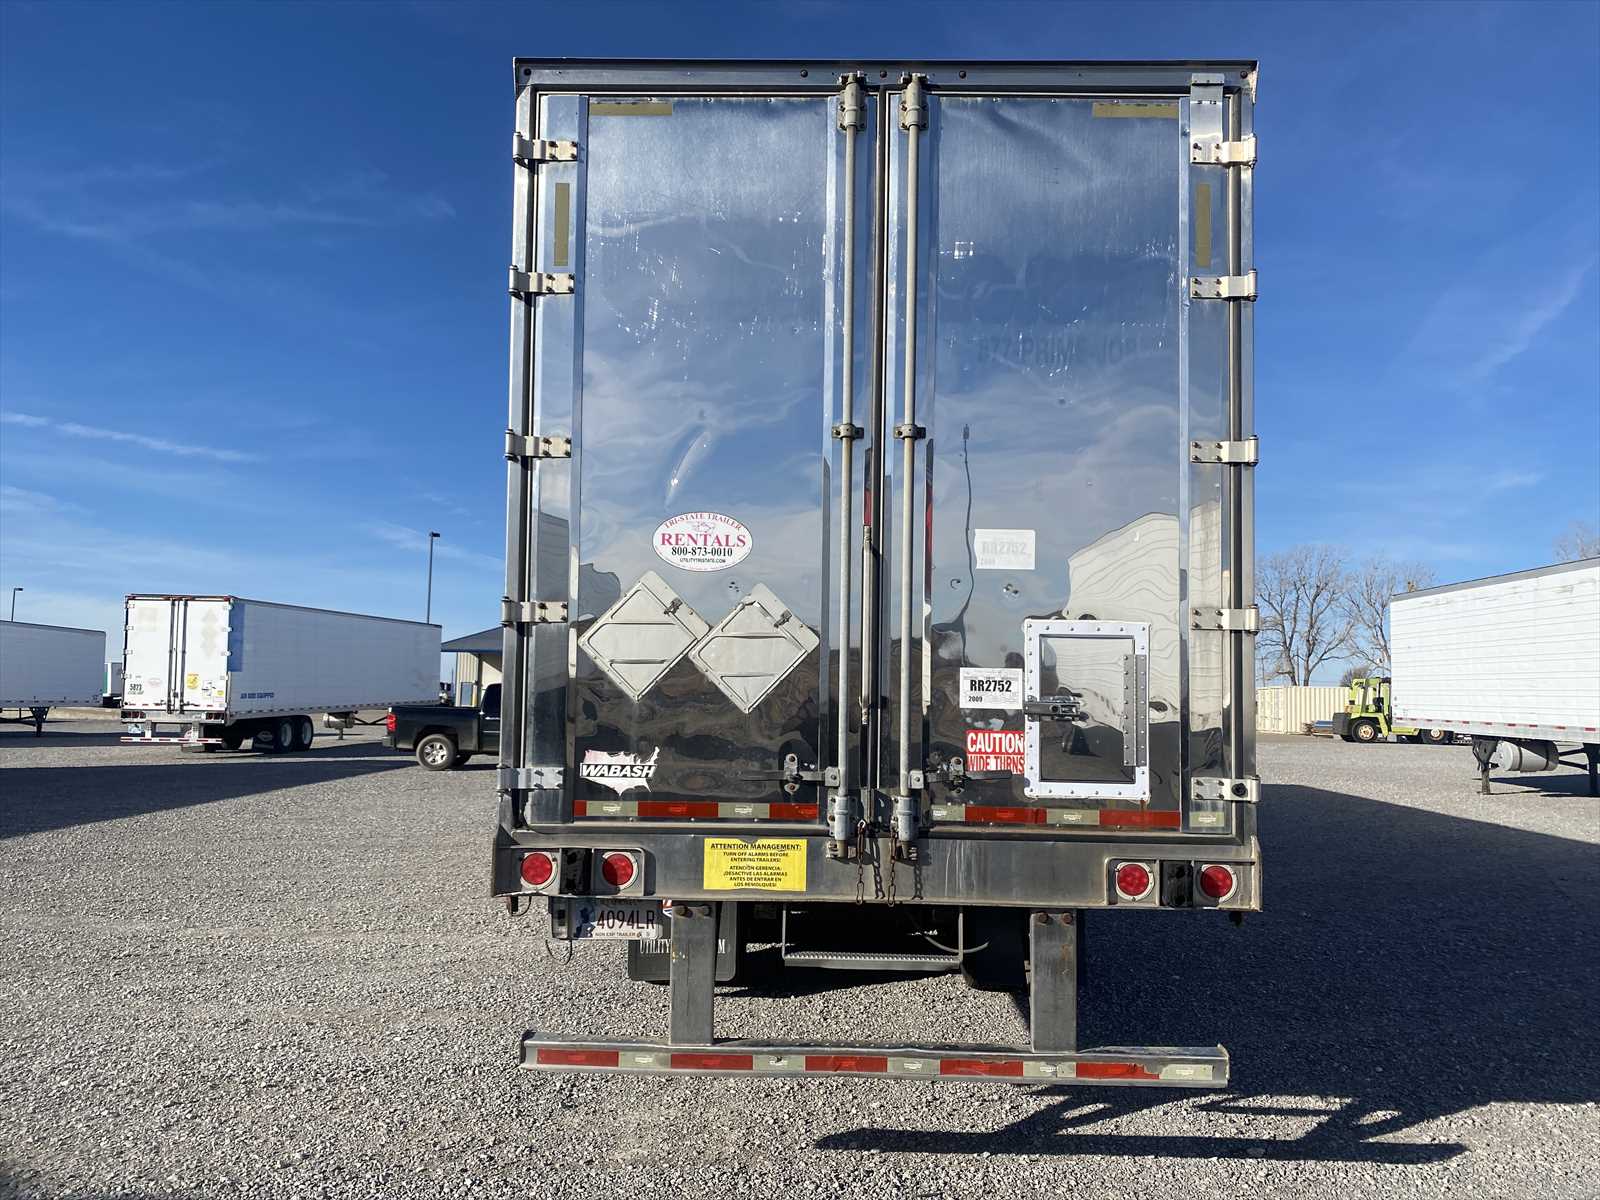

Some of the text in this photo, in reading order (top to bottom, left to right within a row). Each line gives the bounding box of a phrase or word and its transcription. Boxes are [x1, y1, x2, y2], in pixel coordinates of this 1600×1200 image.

[664, 513, 742, 531] TRI-STATE TRAILER
[660, 533, 746, 547] RENTALS
[671, 547, 733, 557] 800-873-0010
[970, 680, 1012, 692] RR2752
[967, 732, 1024, 753] CAUTION
[582, 765, 656, 778] WABASH
[968, 755, 1025, 775] WIDE TURNS
[751, 843, 802, 851] MANAGEMENT:
[597, 910, 655, 929] 4094LR
